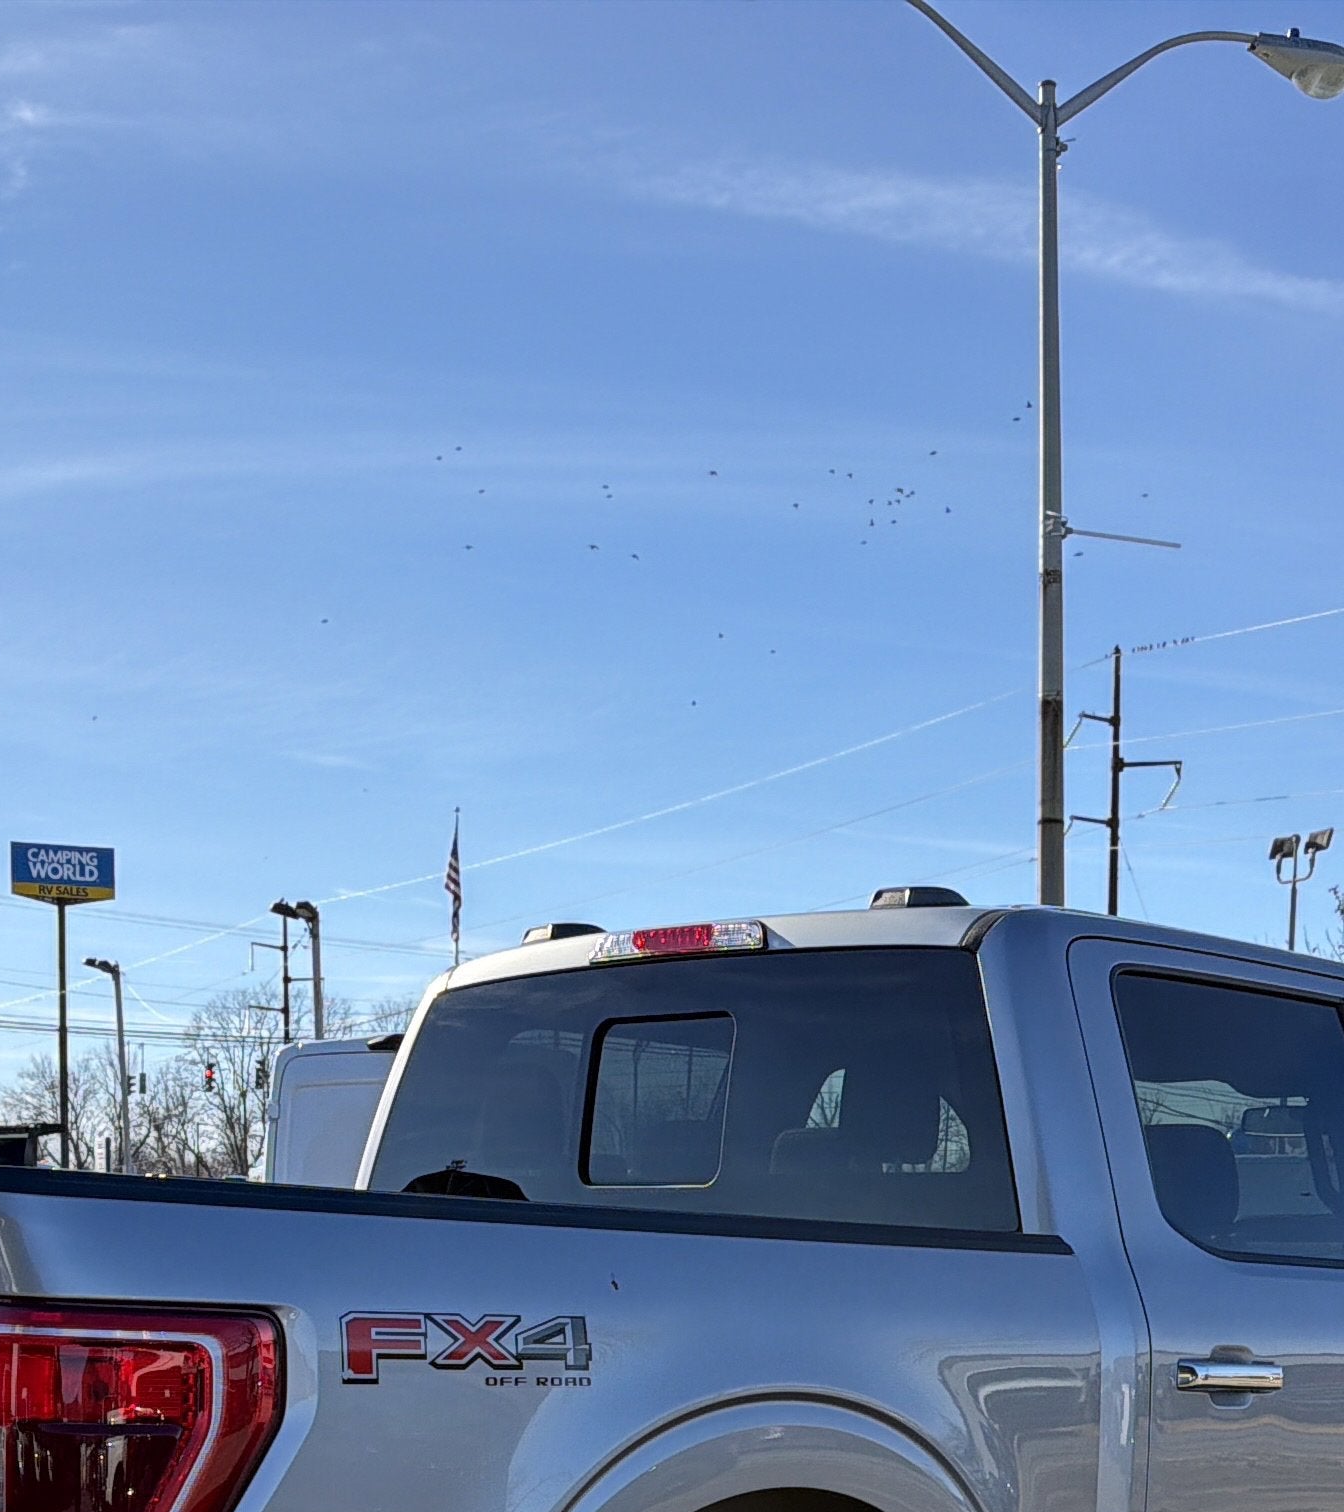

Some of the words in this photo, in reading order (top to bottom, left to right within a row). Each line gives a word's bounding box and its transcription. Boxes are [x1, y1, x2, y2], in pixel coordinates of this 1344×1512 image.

[27, 847, 98, 866] CAMPING
[28, 861, 99, 882] WORLD
[38, 884, 54, 895] RV
[56, 886, 89, 897] SALES
[339, 1310, 593, 1385] FX4
[485, 1376, 528, 1387] OFF
[535, 1376, 592, 1387] ROAD
